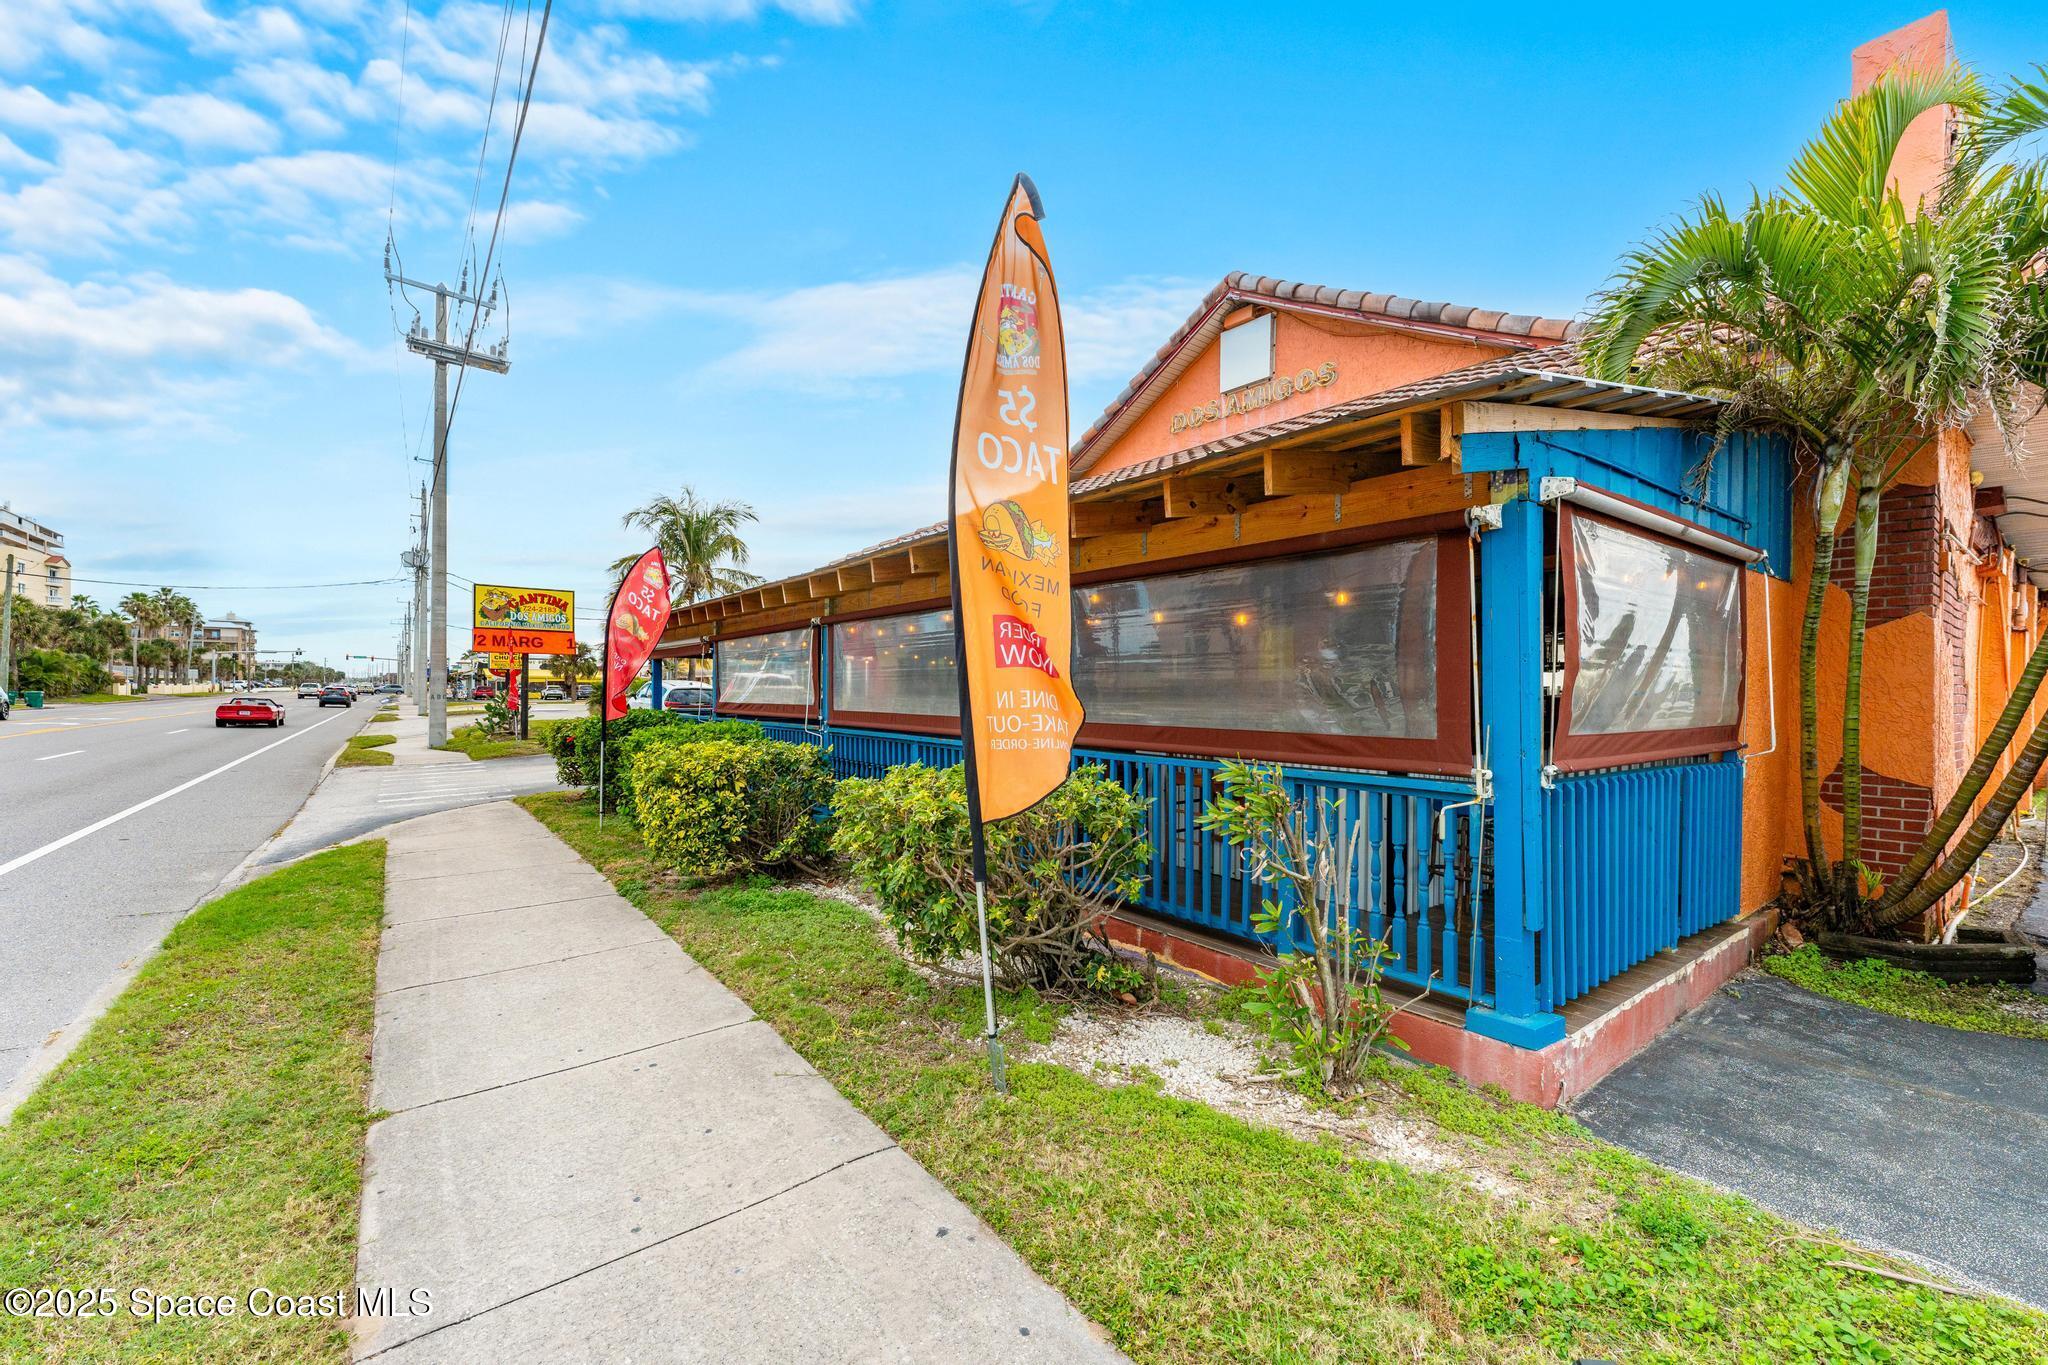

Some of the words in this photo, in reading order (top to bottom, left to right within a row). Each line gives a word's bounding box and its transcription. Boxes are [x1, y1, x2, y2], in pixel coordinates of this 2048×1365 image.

[1170, 399, 1220, 434] DOS
[1223, 361, 1339, 419] AMIGOS
[509, 592, 569, 612] CANTINA
[523, 605, 557, 613] 724-2183
[510, 611, 529, 621] DOS
[532, 612, 567, 623] AMIGOS
